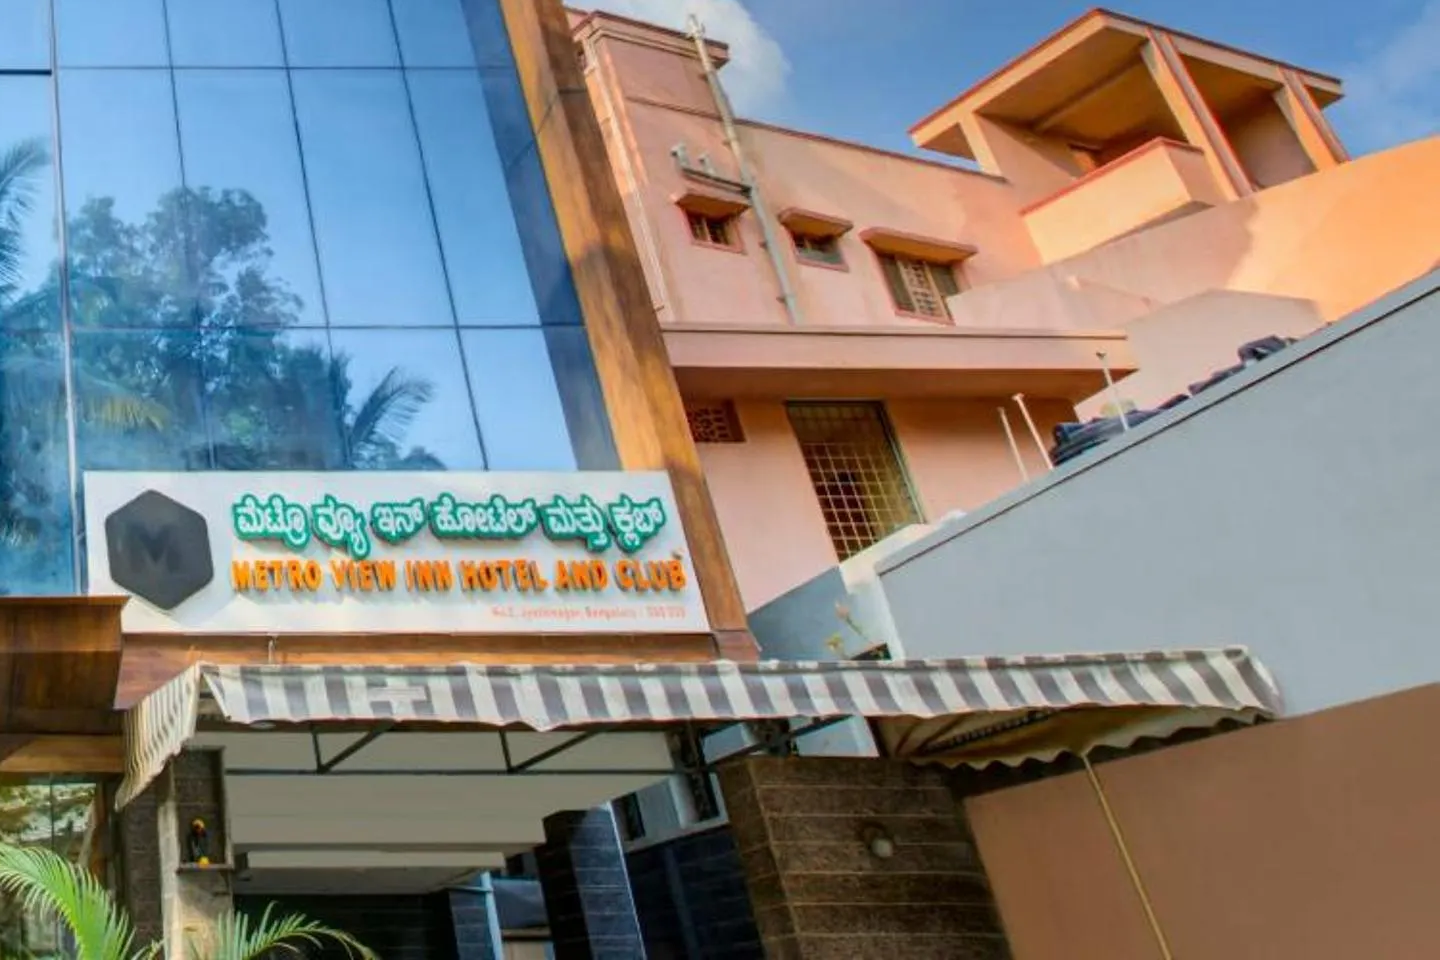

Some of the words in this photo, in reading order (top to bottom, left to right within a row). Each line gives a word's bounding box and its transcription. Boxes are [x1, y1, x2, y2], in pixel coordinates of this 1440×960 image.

[371, 497, 426, 543] ಇನ್
[429, 493, 539, 537] ಹೋಟೆಲ್
[540, 494, 610, 552] ಮತ್ತು
[609, 493, 666, 552] ಕ್ಲಬ್
[230, 559, 323, 592] METRO
[330, 559, 397, 592] VIEW
[405, 559, 453, 592] INN
[459, 559, 548, 592] HOTEL
[555, 559, 608, 592] AND
[615, 559, 686, 592] CLUB
